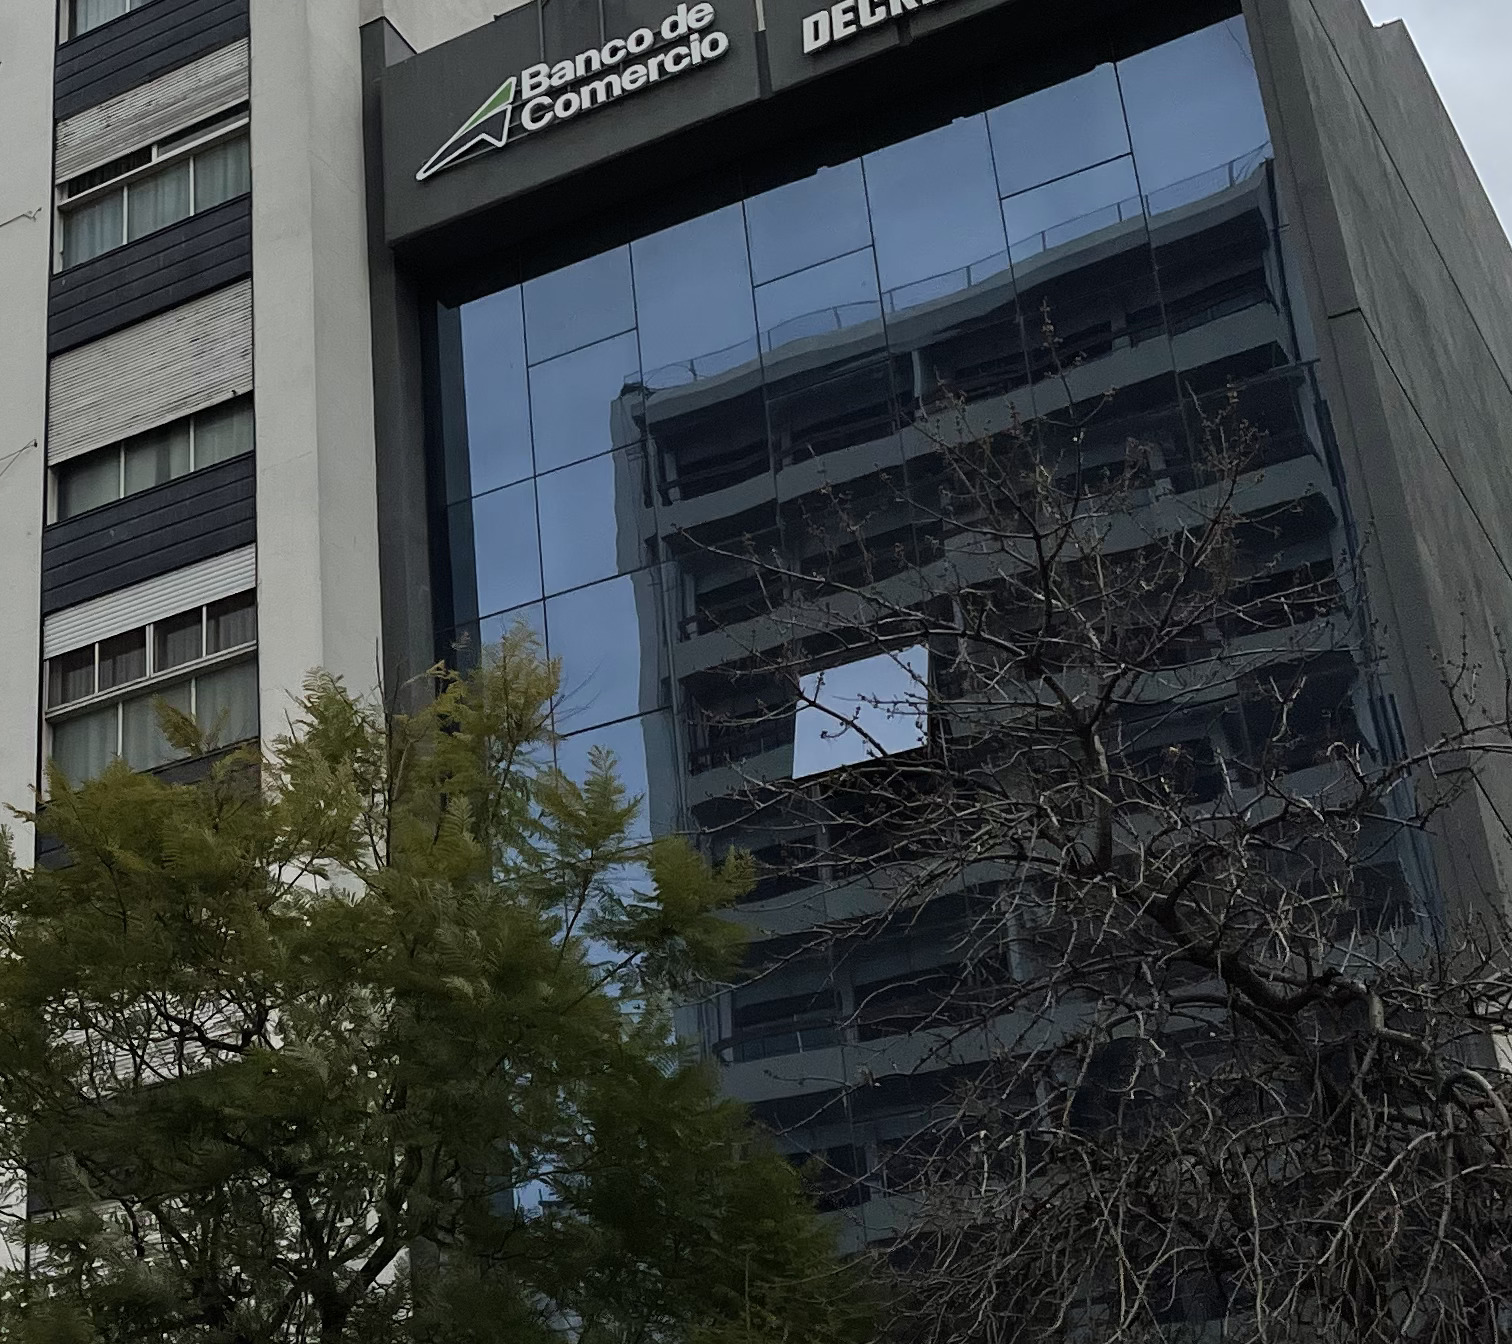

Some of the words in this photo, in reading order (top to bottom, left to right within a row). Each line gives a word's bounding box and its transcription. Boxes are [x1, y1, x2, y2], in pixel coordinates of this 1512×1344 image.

[520, 31, 729, 131] Comercio
[521, 27, 654, 100] Banco
[660, 2, 716, 40] de
